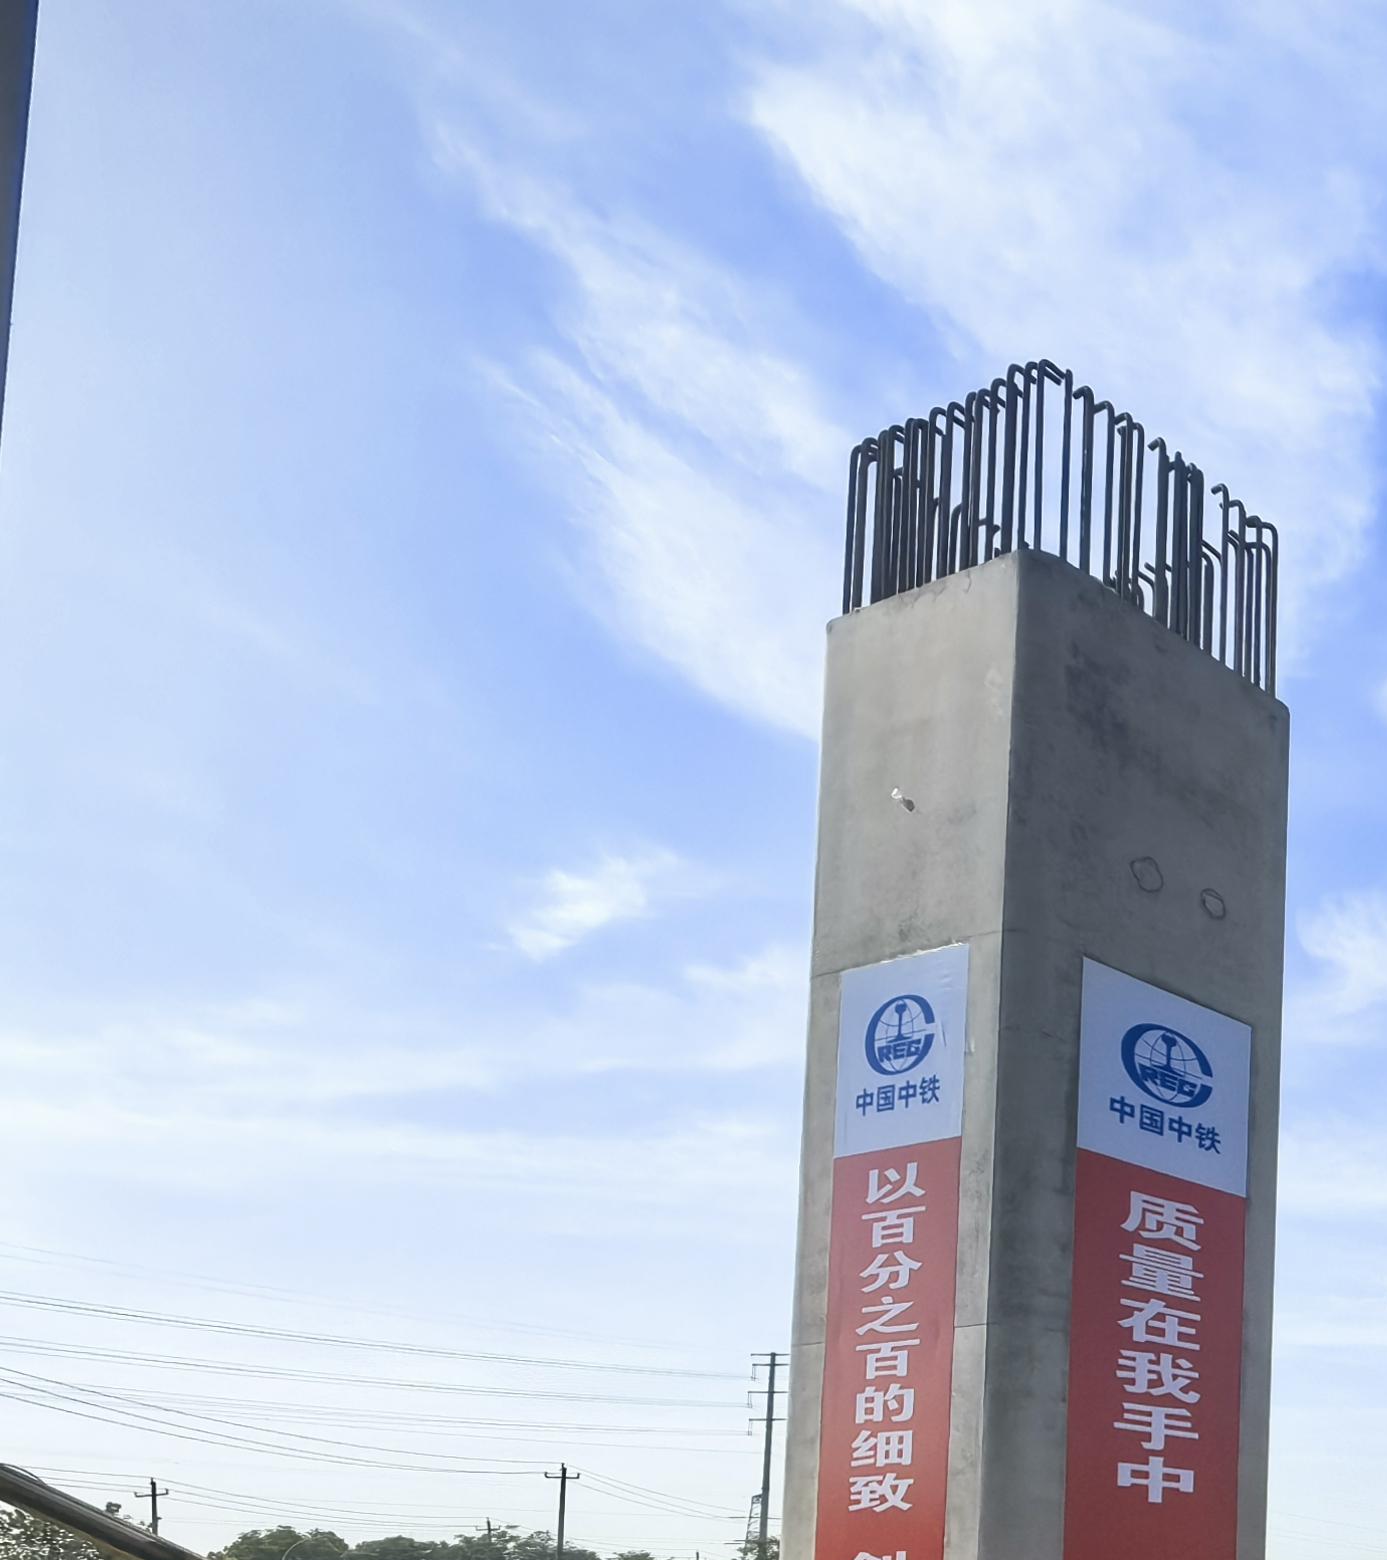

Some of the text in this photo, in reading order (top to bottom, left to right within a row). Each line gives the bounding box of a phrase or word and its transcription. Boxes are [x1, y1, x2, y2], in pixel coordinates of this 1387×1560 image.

[855, 1074, 941, 1117] 中国中铁
[1109, 1095, 1221, 1155] 中国中铁
[848, 1162, 926, 1513] 以百分之百的细致
[1113, 1190, 1204, 1504] 质量在我手中
